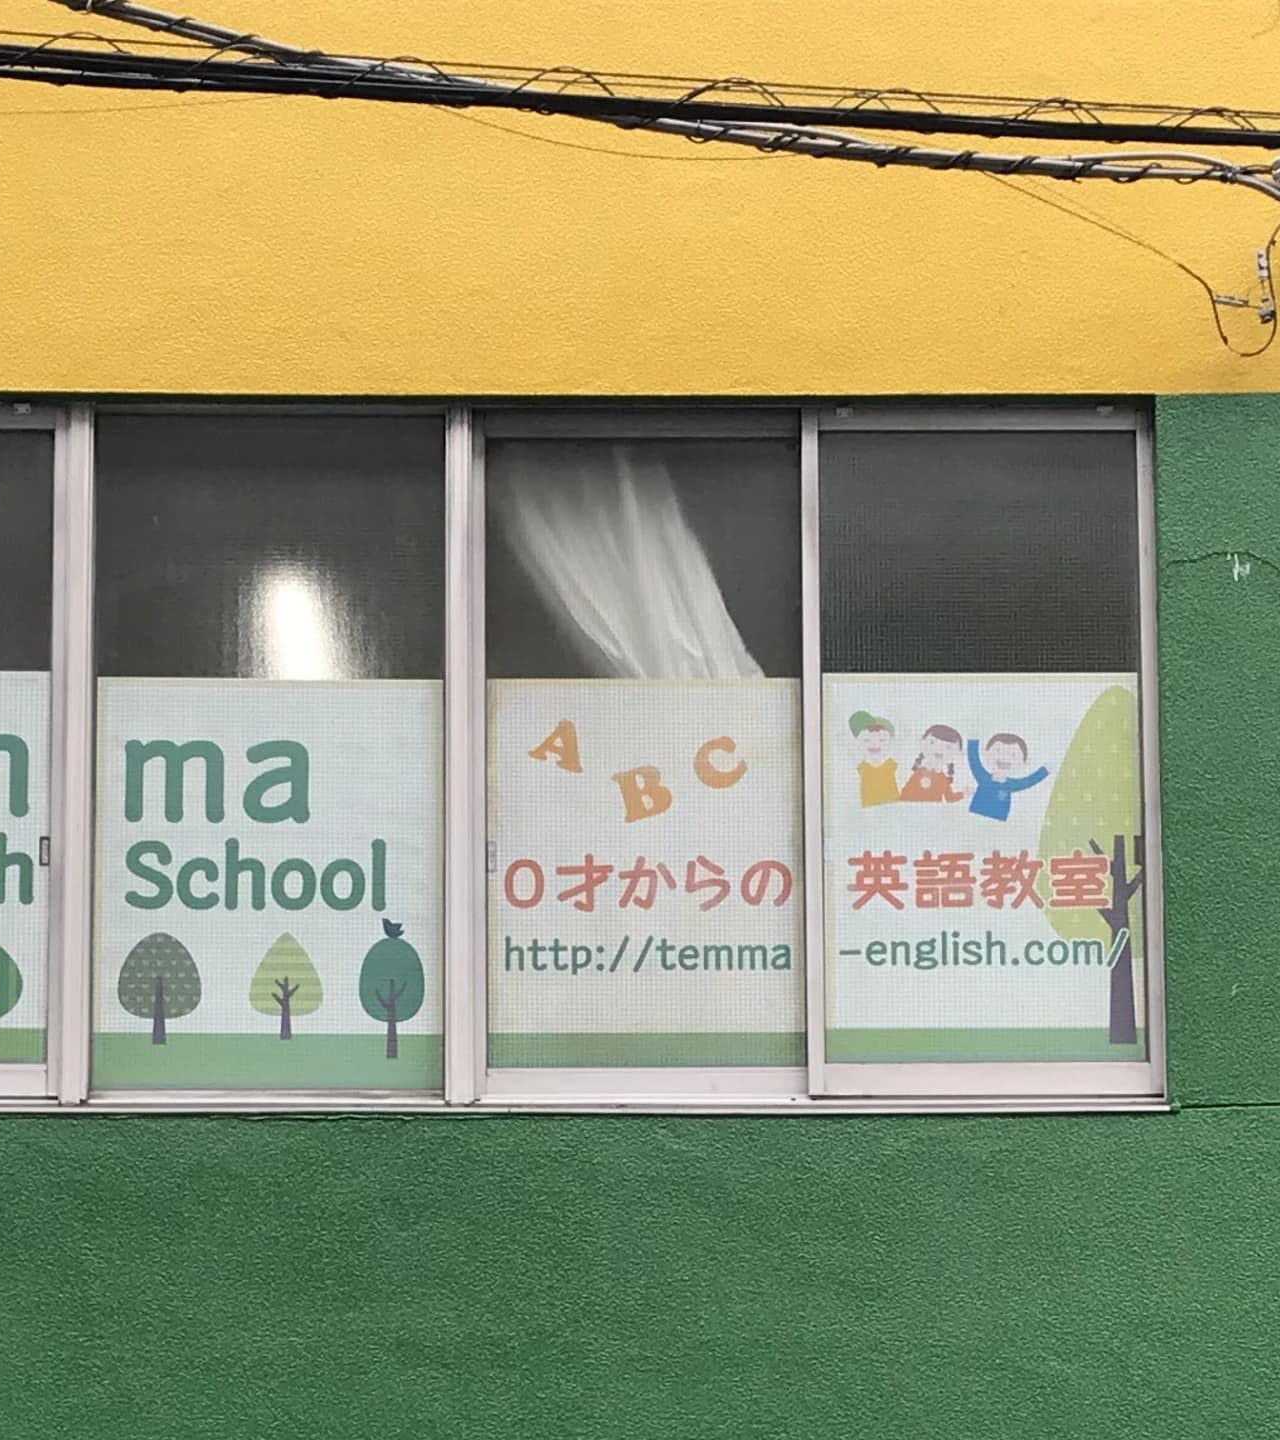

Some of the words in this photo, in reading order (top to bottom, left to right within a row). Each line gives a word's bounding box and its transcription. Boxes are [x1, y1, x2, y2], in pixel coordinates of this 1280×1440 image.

[124, 739, 310, 823] ma
[124, 837, 387, 913] School
[846, 848, 1112, 911] 英語教室
[504, 936, 792, 977] http://temma
